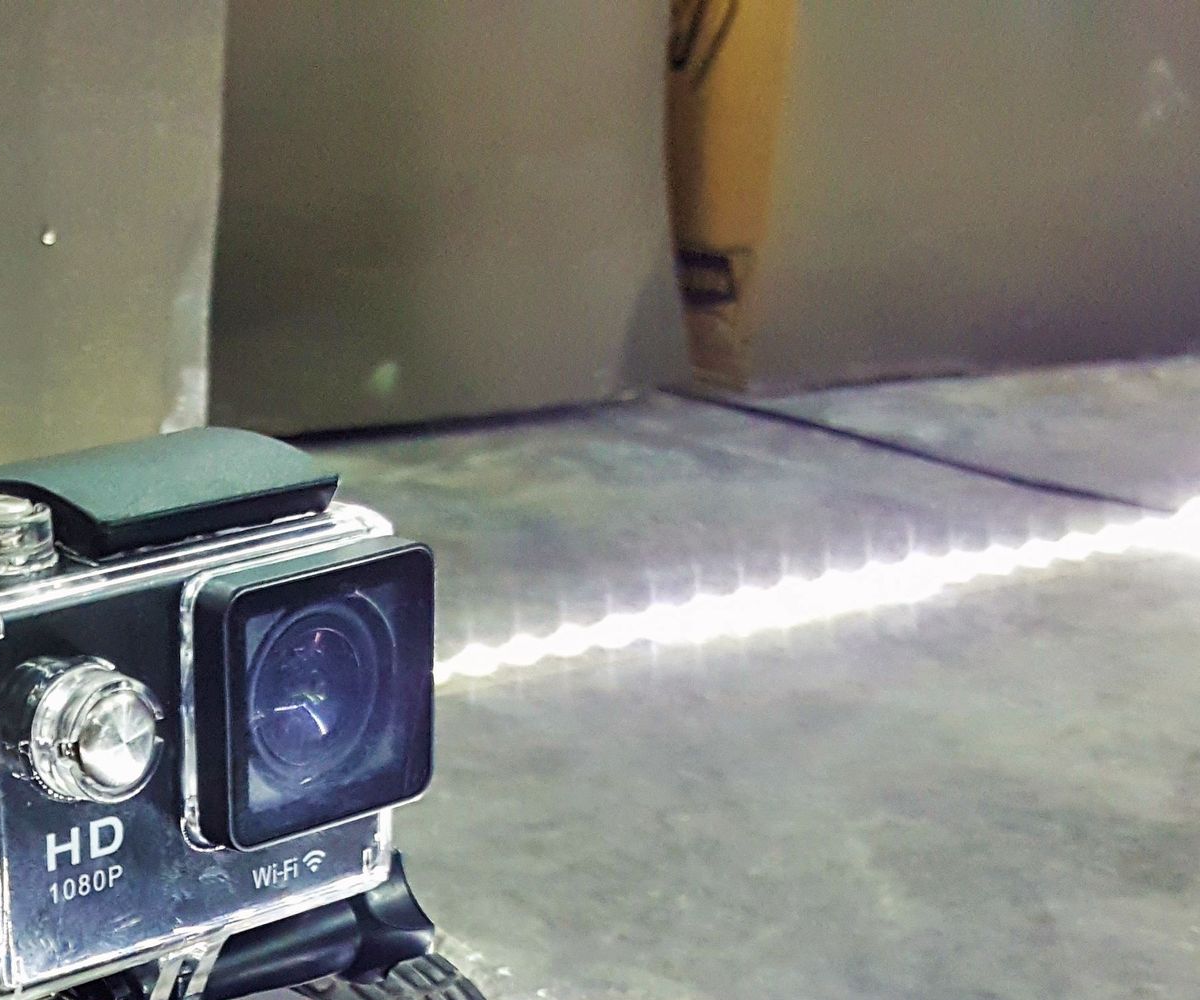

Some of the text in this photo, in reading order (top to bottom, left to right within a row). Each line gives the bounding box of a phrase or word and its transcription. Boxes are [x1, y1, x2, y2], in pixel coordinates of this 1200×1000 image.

[46, 816, 124, 872] HD
[49, 865, 124, 904] 1080P
[252, 857, 298, 889] Wi-Fi
